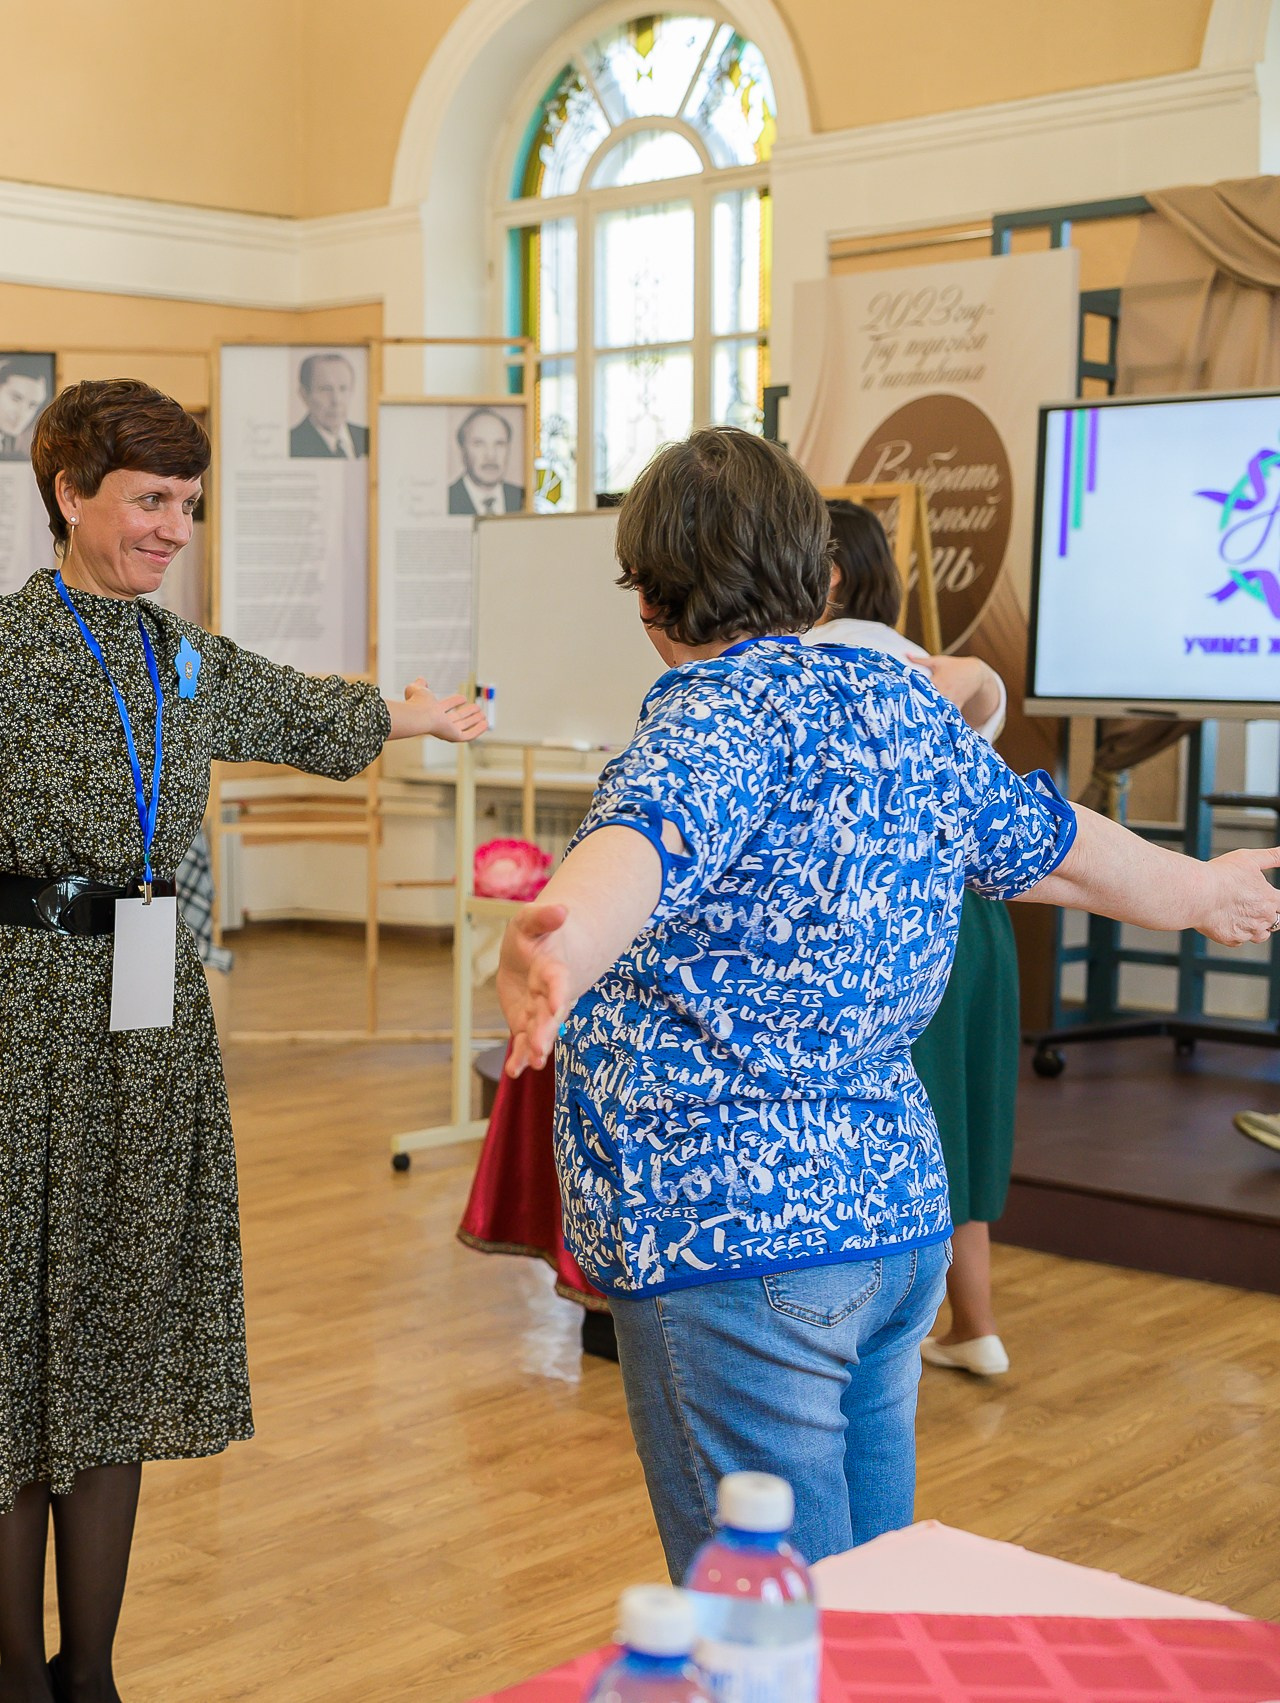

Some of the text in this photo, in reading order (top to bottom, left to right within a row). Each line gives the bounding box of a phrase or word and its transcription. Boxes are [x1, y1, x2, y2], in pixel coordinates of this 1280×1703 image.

[859, 284, 963, 331] 2023
[1184, 637, 1258, 654] УЧИМСЯ
[716, 979, 823, 1007] STREETS
[740, 1004, 843, 1034] URBAN
[634, 1206, 698, 1221] STREETS
[727, 1228, 827, 1259] STREETS
